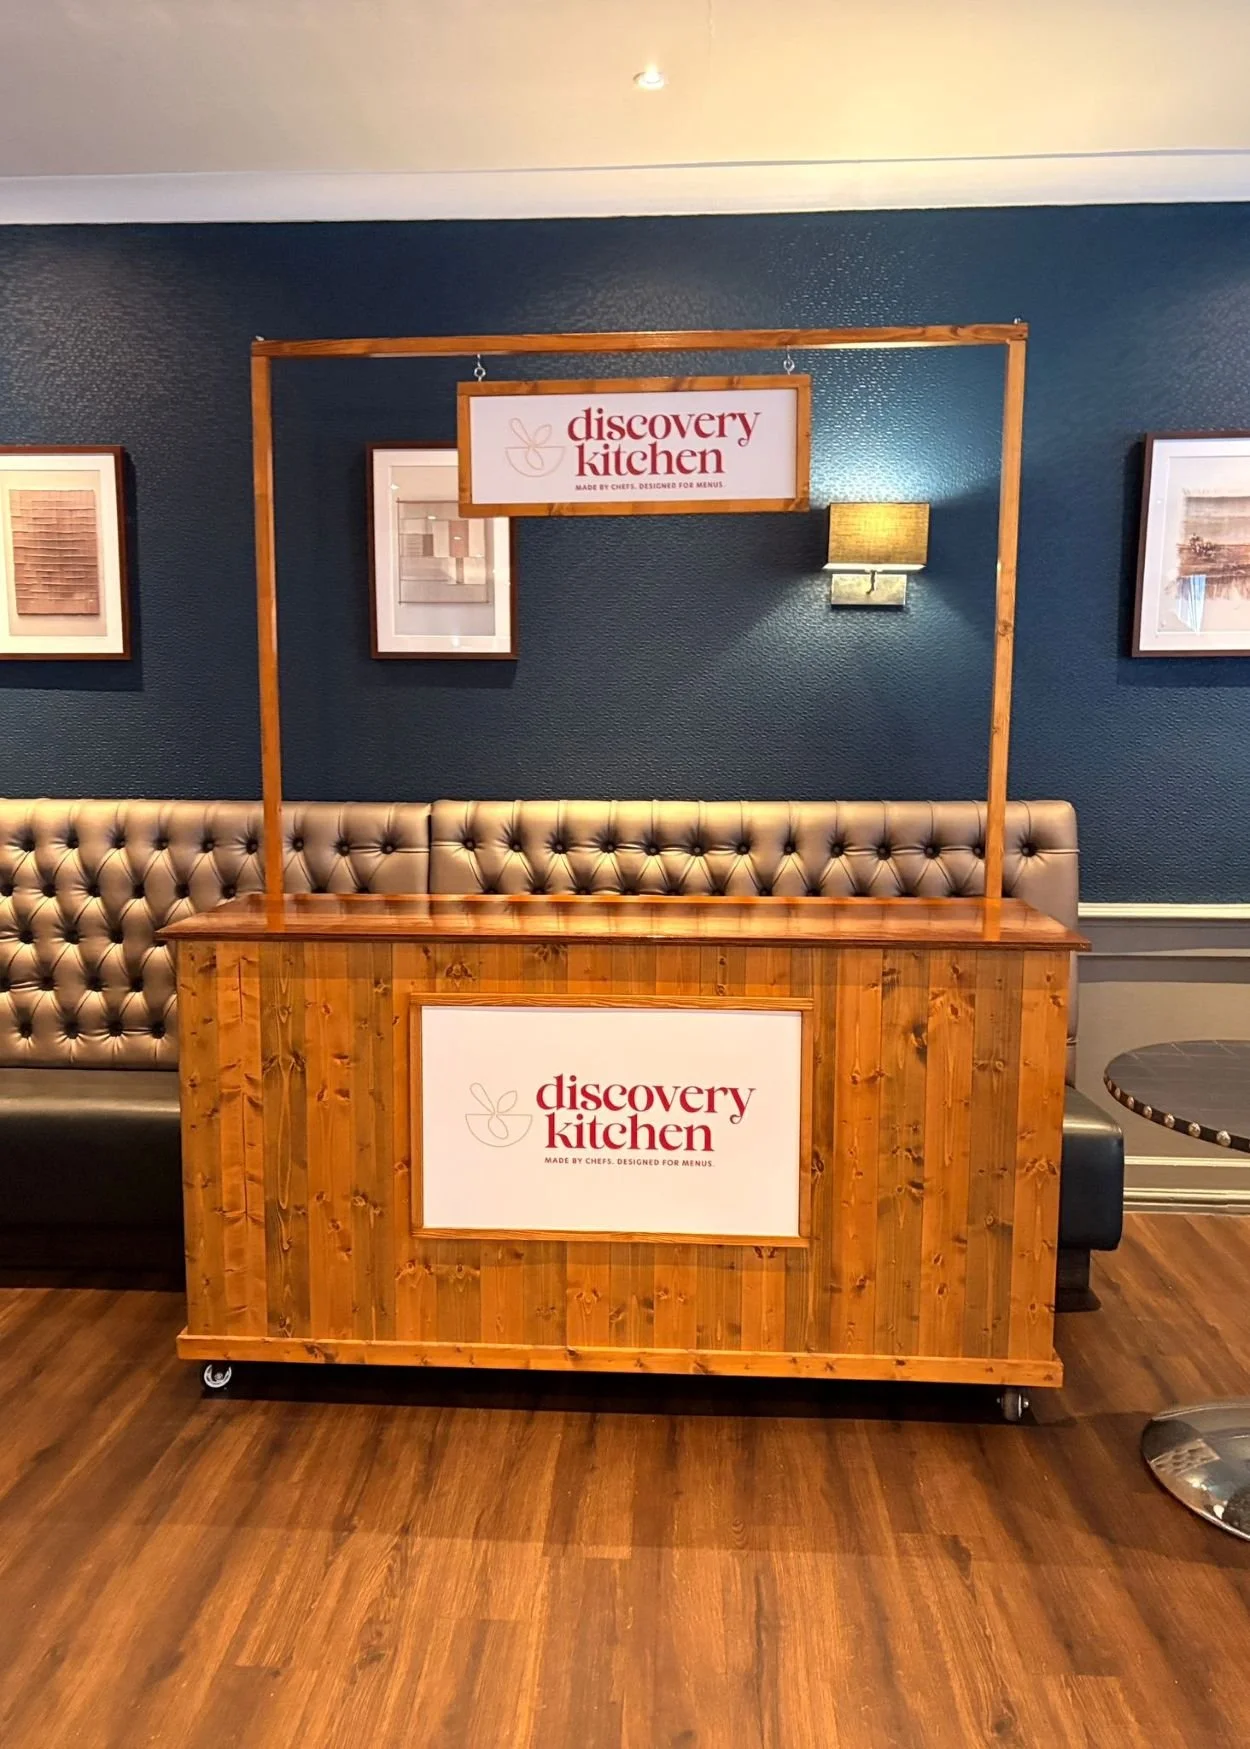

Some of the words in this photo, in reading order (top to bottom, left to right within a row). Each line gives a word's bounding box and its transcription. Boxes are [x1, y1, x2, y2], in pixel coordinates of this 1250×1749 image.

[567, 406, 762, 447] discovery
[575, 441, 726, 477] kitchen
[575, 483, 597, 491] MADE
[599, 483, 609, 491] BY
[611, 483, 637, 491] CHEFS.
[639, 482, 677, 490] DESIGNED
[679, 481, 694, 489] FOR
[536, 1073, 757, 1125] discovery
[544, 1113, 715, 1152] kitchen
[544, 1157, 569, 1165] MADE
[572, 1157, 583, 1165] BY
[585, 1157, 615, 1165] CHEFS.
[617, 1158, 660, 1166] DESIGNED
[662, 1159, 680, 1167] FOR
